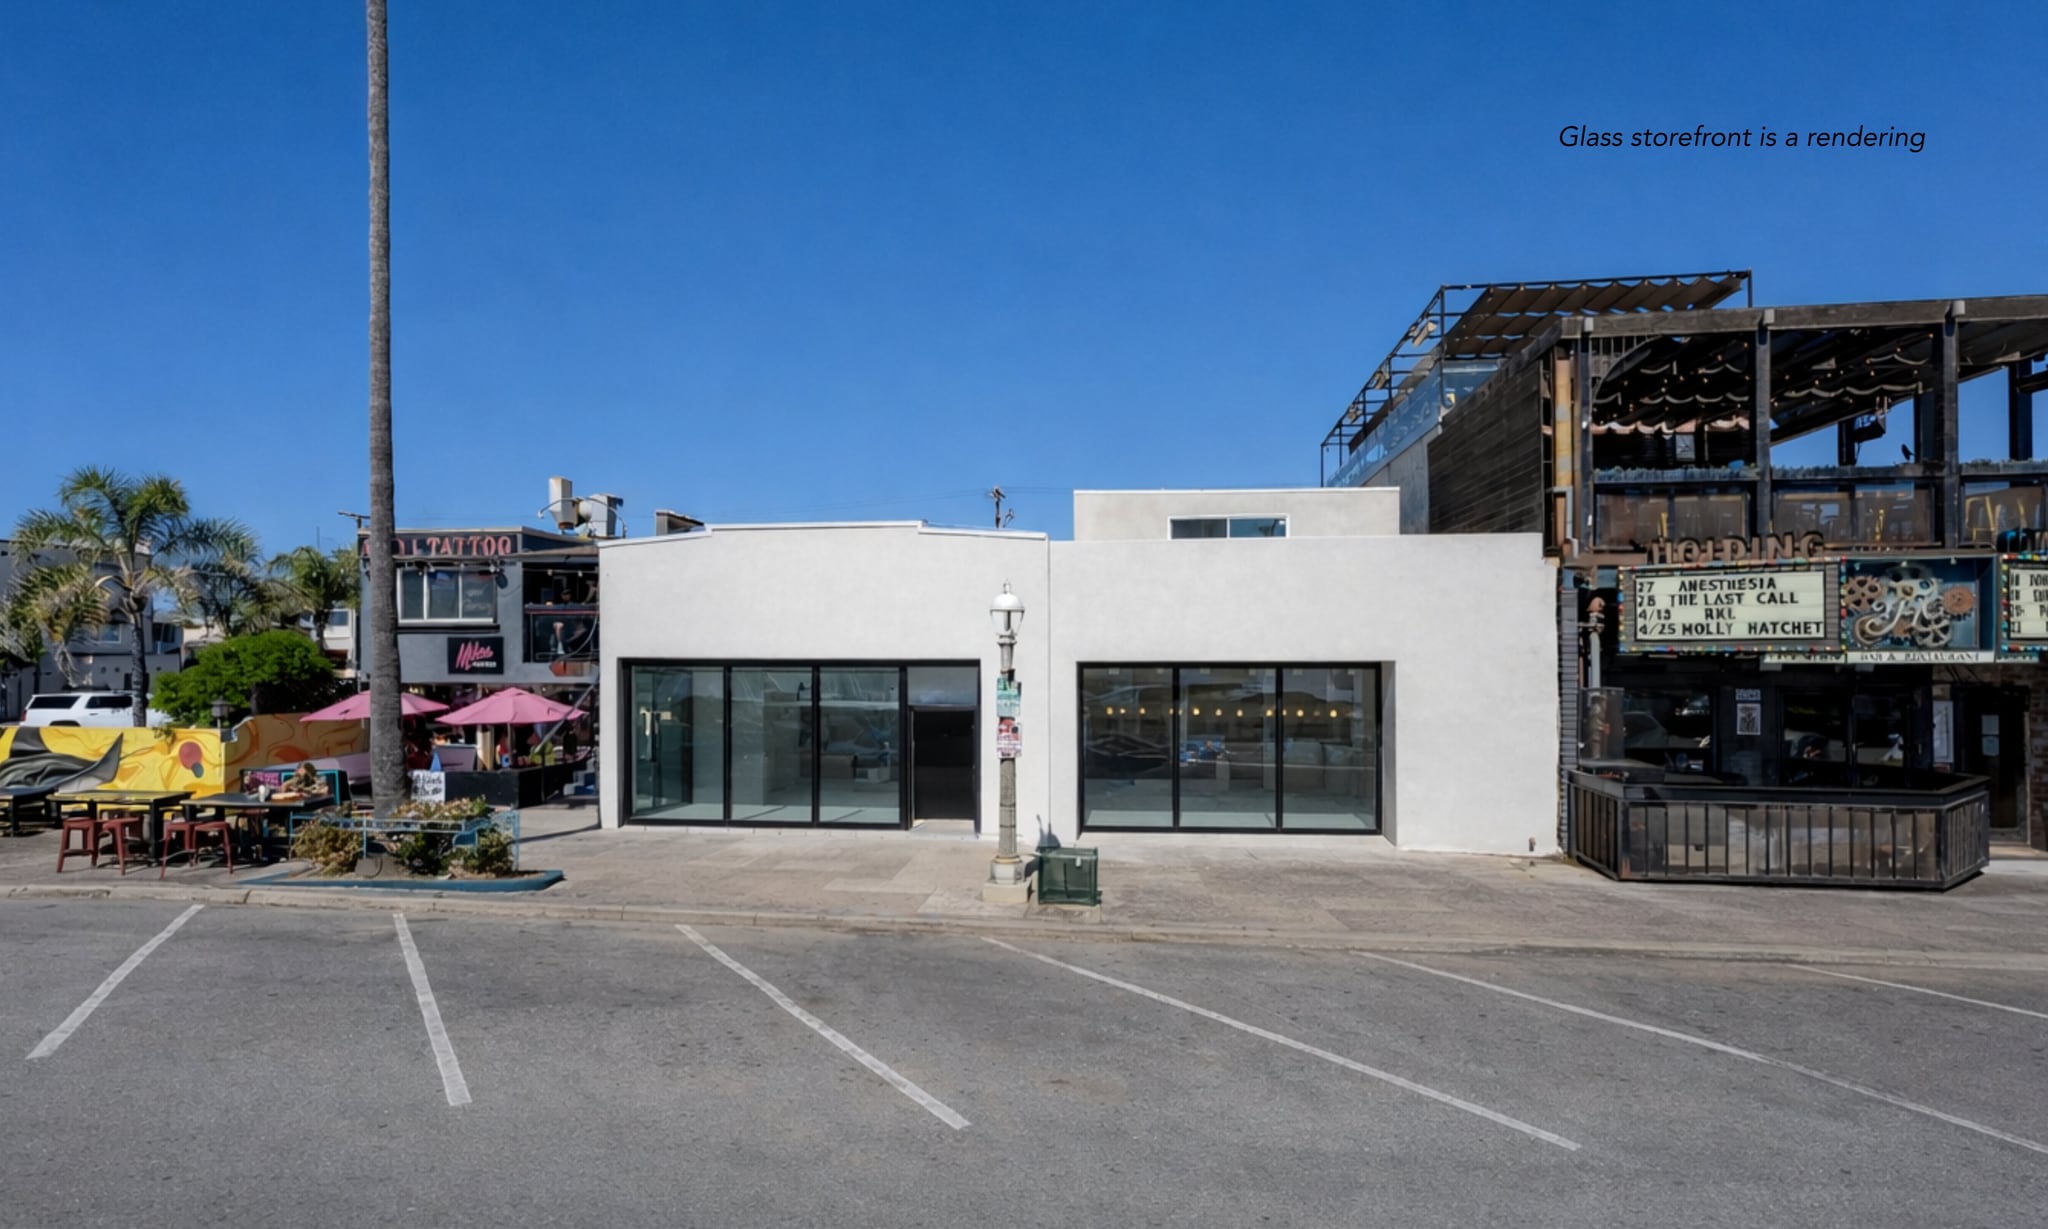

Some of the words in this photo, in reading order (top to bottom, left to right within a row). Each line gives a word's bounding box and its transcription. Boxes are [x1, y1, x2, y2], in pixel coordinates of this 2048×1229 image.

[426, 536, 512, 556] TATTOO
[1651, 531, 1825, 565] HOLDING
[1678, 577, 1776, 592] ANESTHESIA
[1669, 593, 1698, 607] THE
[1704, 592, 1744, 606] LAST
[1756, 591, 1799, 605] CALL
[1681, 621, 1733, 636] MOLLY
[1747, 621, 1824, 635] HATCHET
